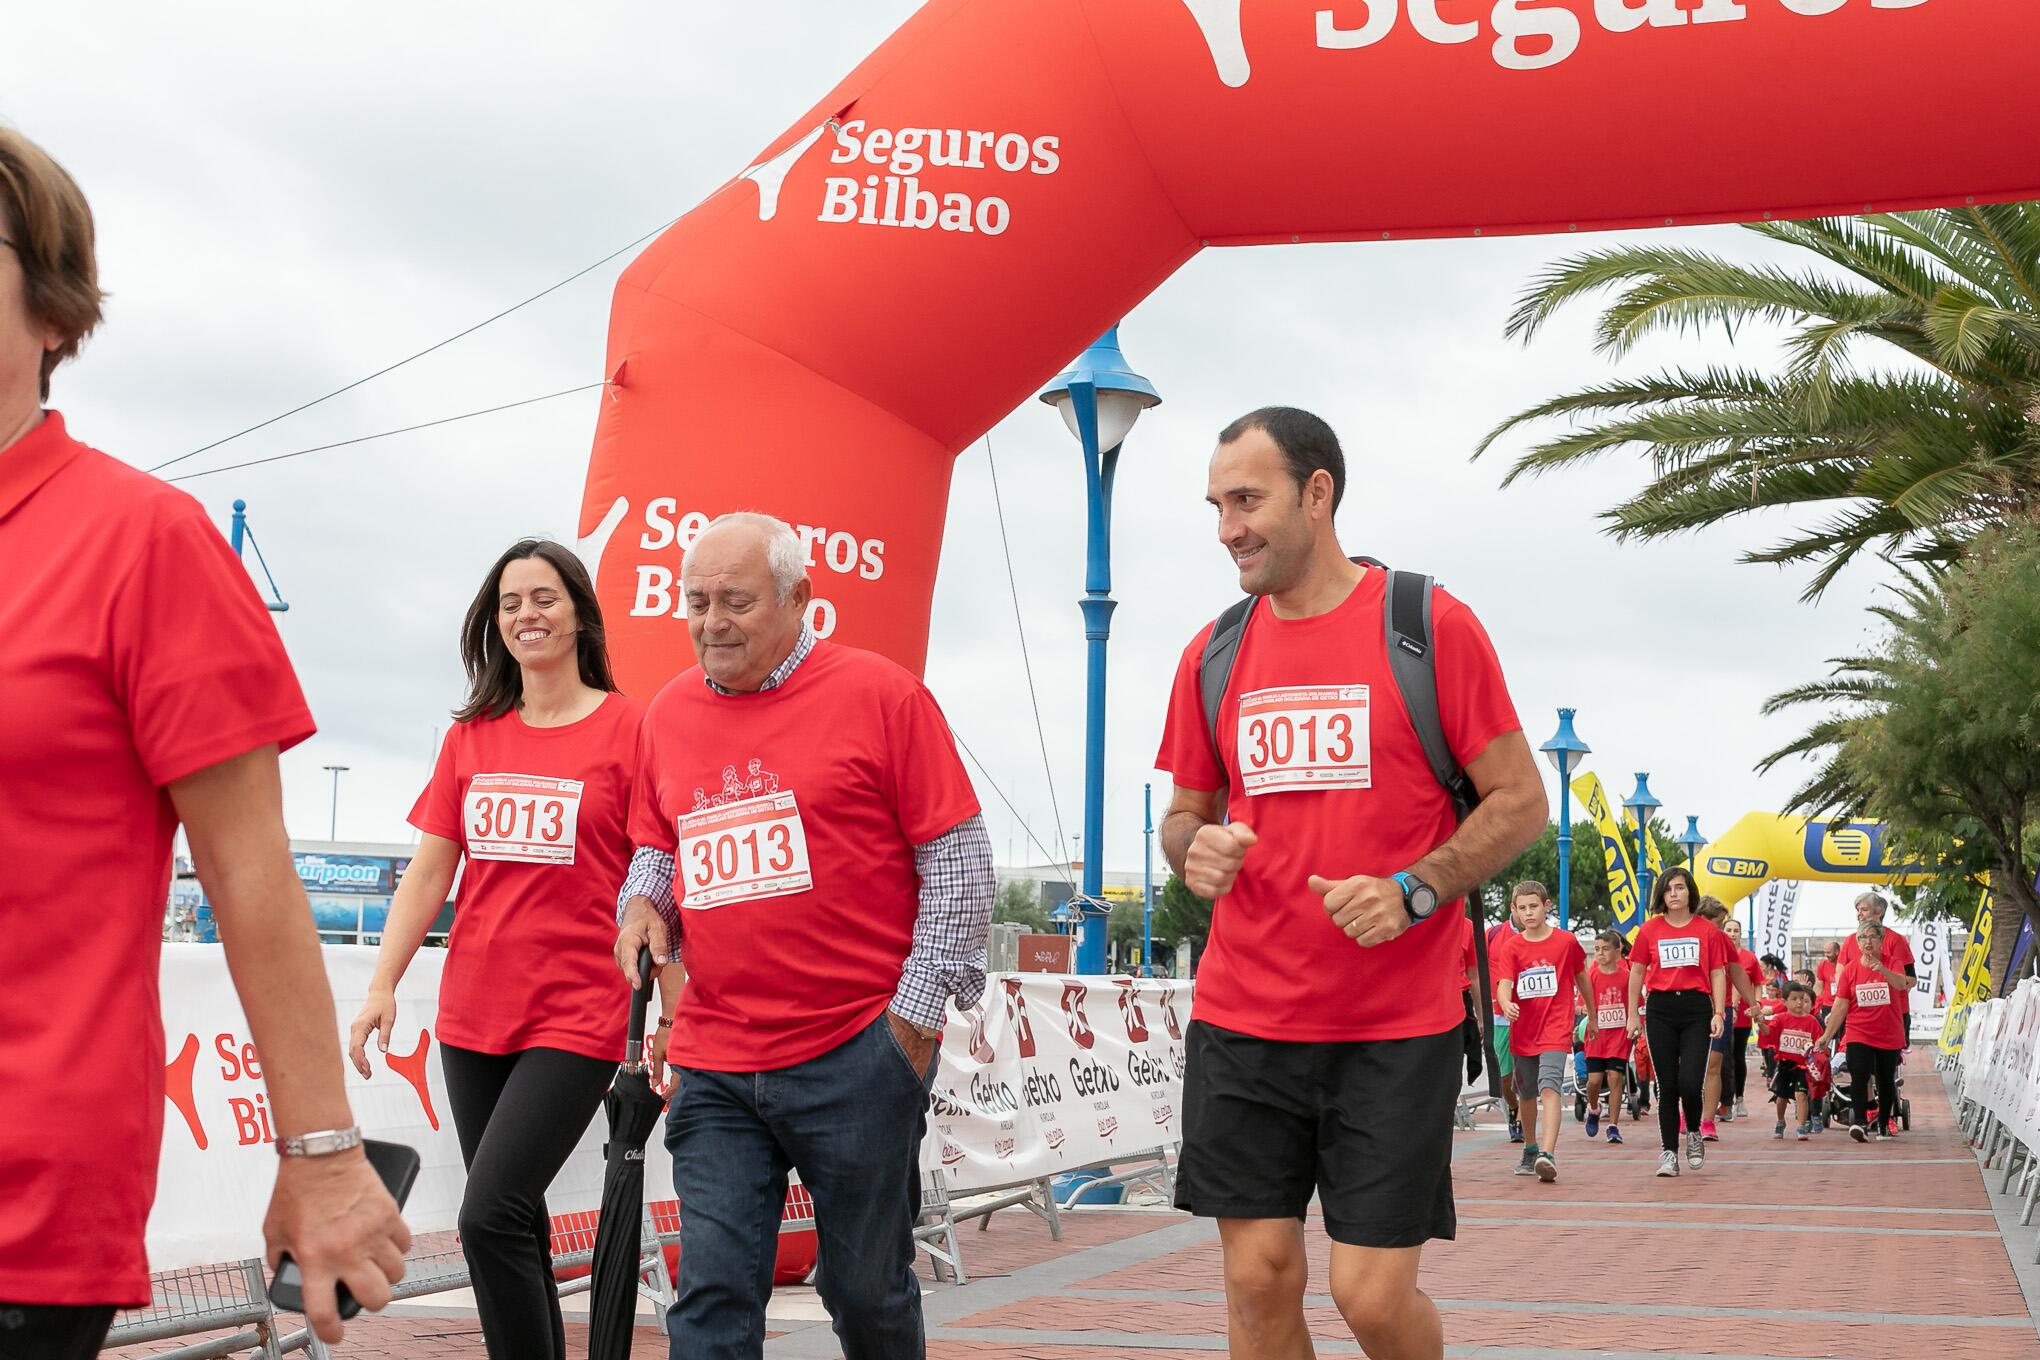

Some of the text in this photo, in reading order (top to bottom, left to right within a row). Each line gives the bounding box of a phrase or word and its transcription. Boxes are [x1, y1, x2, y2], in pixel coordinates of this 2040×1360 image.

[830, 120, 1061, 175] Seguros
[817, 174, 1011, 236] Bilbao
[639, 497, 885, 581] Seros
[629, 565, 837, 640] Bio
[1249, 713, 1354, 769] 3013
[474, 796, 564, 842] 3013
[692, 823, 794, 887] 3013
[1733, 861, 1764, 877] BM
[1664, 945, 1696, 960] 1011
[1921, 923, 1938, 966] COR
[1522, 975, 1552, 991] 1011
[1859, 989, 1887, 1002] 3002
[1917, 970, 1932, 994] EL
[1600, 1010, 1624, 1023] 3002
[970, 1072, 1019, 1114] Getxo
[1069, 1057, 1120, 1098] Getxo
